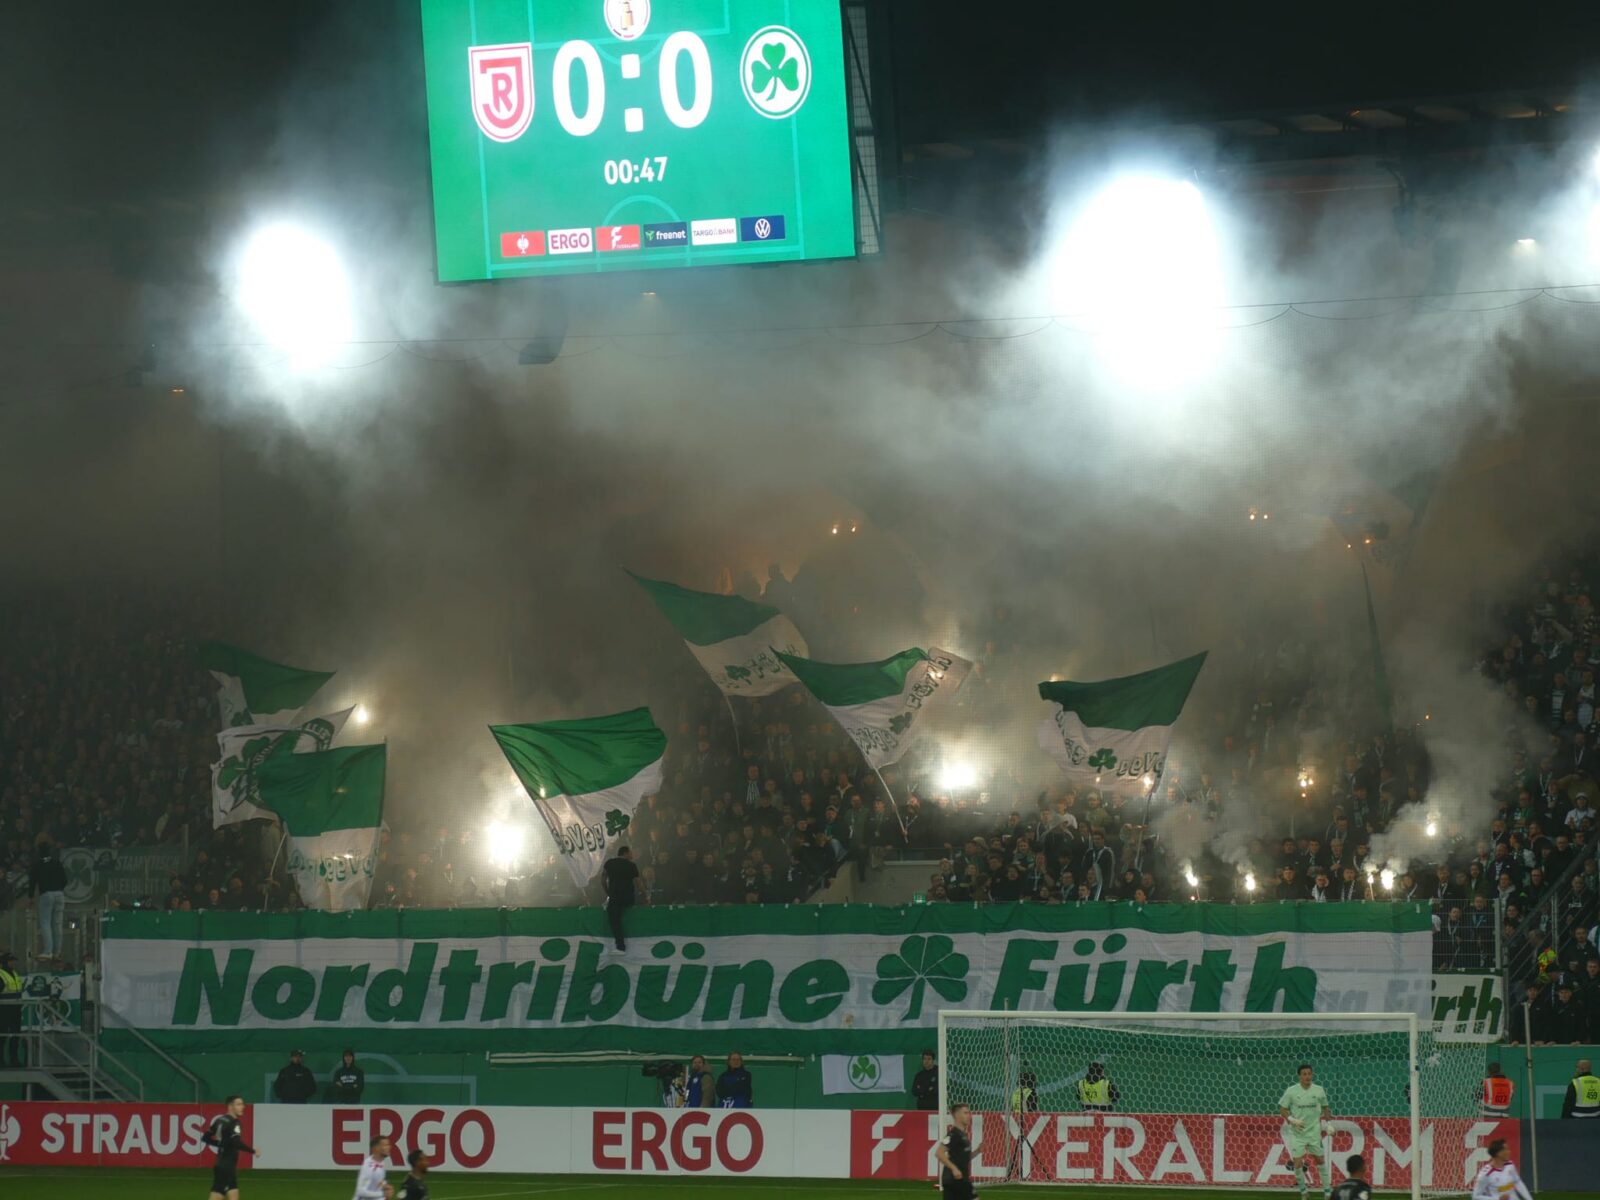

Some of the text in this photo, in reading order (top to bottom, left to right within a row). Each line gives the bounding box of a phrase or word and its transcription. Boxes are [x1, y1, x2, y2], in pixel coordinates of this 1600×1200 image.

[604, 157, 668, 185] 00:47
[550, 233, 590, 250] ERGO
[655, 230, 686, 240] freenet
[172, 933, 1317, 1026] Nordtribüne Fürth
[1432, 978, 1502, 1034] rth
[332, 1107, 495, 1169] ERGO
[592, 1111, 764, 1173] ERGO
